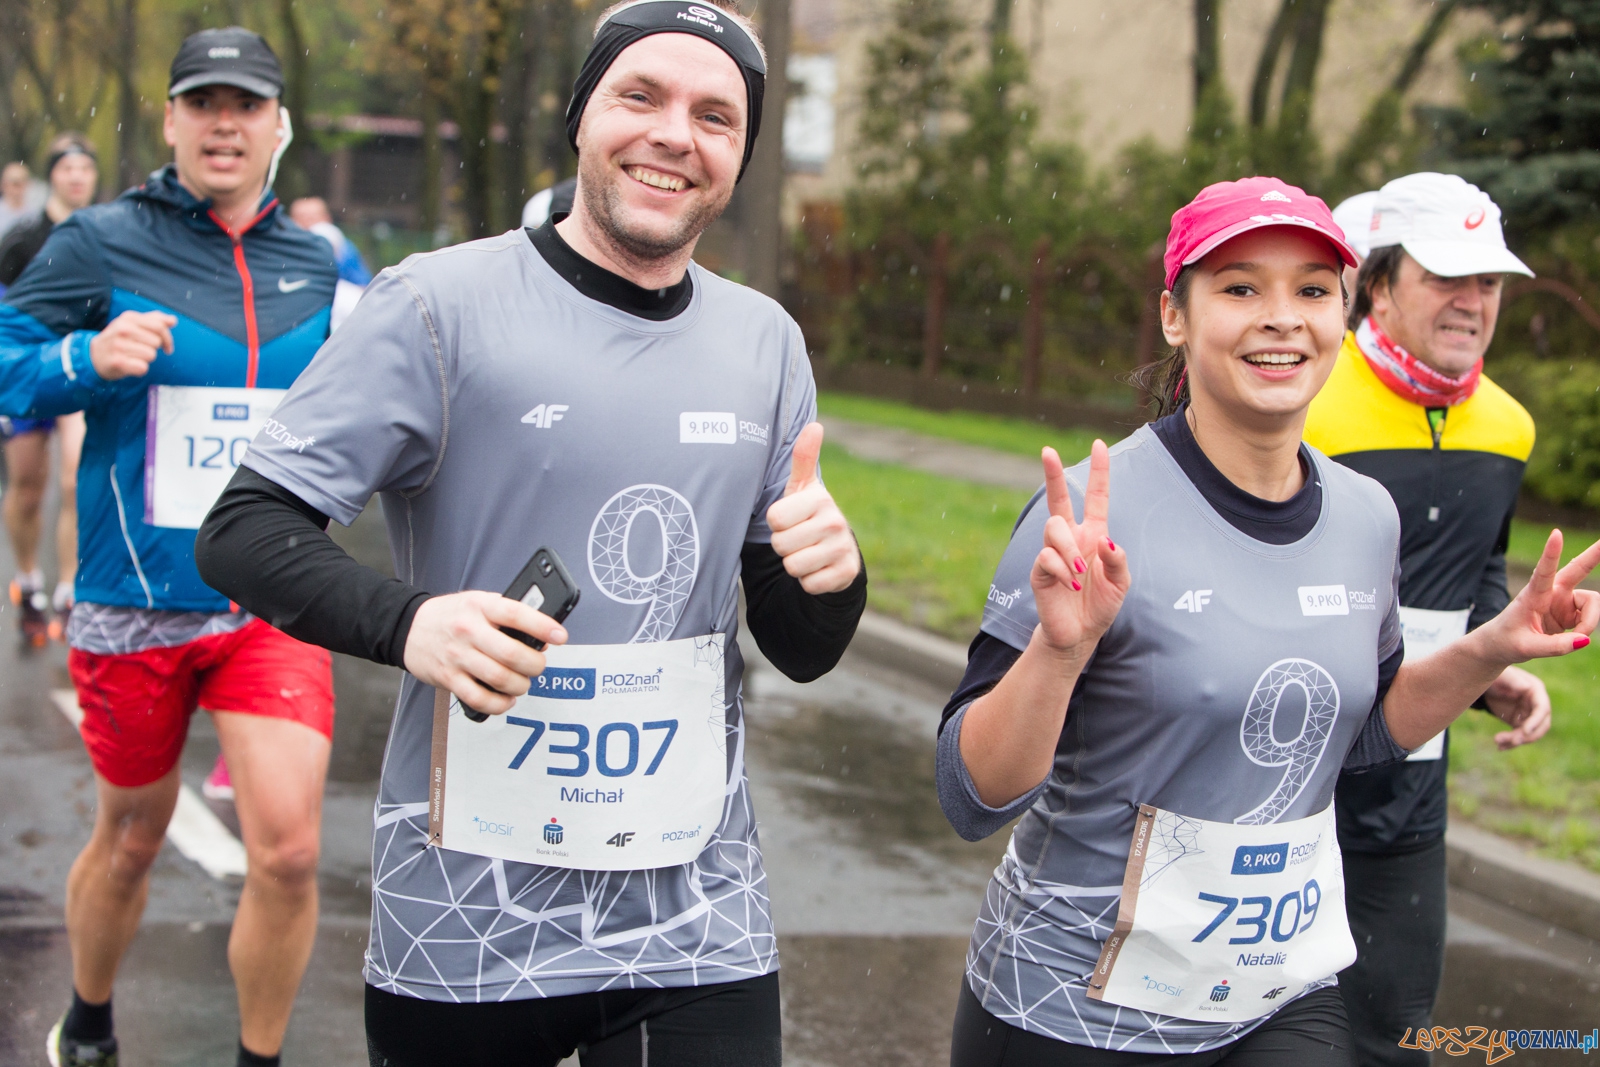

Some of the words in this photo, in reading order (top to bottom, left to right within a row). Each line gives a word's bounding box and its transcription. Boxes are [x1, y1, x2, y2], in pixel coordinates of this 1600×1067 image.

[520, 403, 570, 429] 4F
[689, 421, 700, 434] 9.
[702, 421, 729, 434] PKO
[1173, 589, 1213, 613] 4F
[1306, 595, 1317, 608] 9.
[1317, 593, 1342, 607] PKO
[537, 676, 549, 691] 9.
[551, 677, 587, 692] PKO
[601, 684, 661, 695] PÓŁMARATON
[505, 715, 680, 778] 7307
[560, 786, 625, 804] Michał
[605, 831, 636, 848] 4F
[1134, 820, 1149, 857] 17.04.2016
[536, 847, 551, 856] Bank
[552, 849, 569, 858] Polski
[1243, 853, 1253, 868] 9.
[1254, 851, 1281, 867] PKO
[1191, 878, 1322, 946] 7309
[1236, 951, 1288, 967] Natalia
[1261, 986, 1287, 1000] 4F
